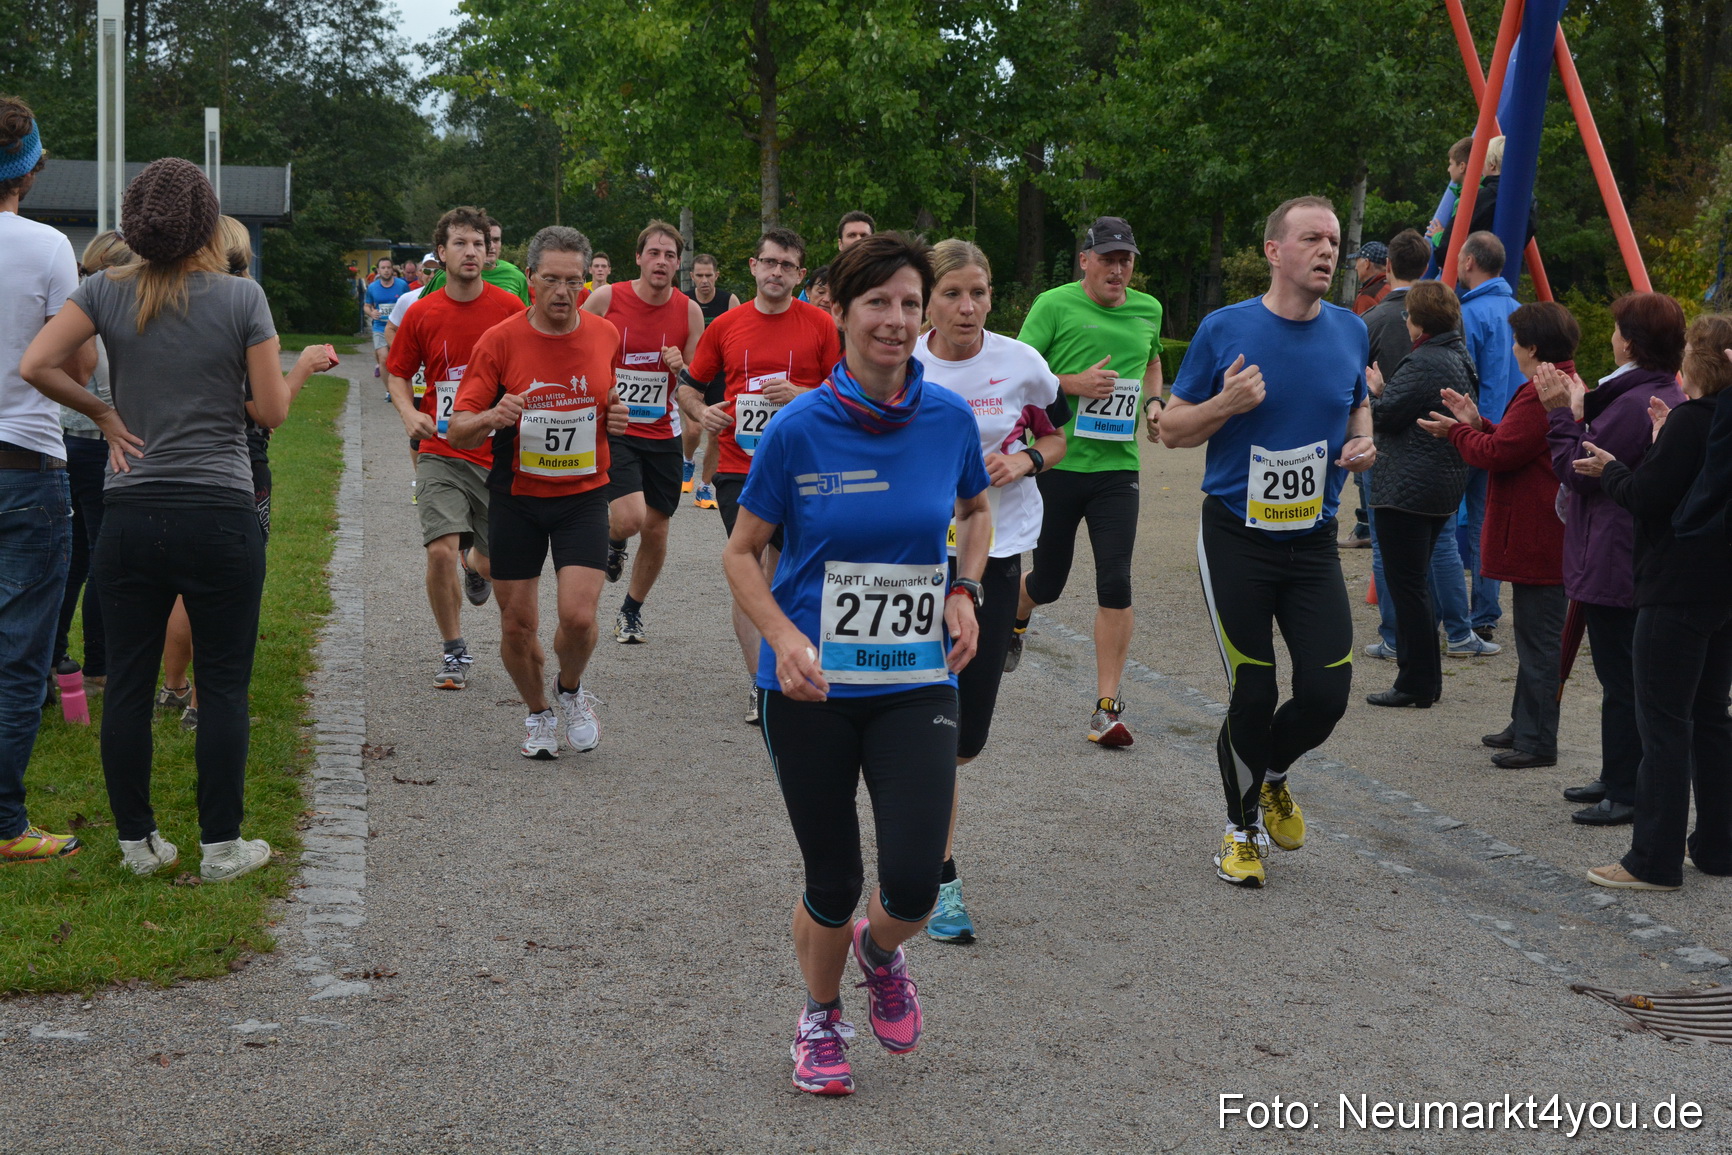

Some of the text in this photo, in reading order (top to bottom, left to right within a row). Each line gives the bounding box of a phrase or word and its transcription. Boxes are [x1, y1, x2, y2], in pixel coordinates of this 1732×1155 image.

[545, 392, 566, 401] Mitte
[617, 381, 663, 404] 2227
[527, 396, 595, 410] KASSEL MARATHON
[737, 399, 786, 408] PARTL Neumar
[966, 397, 1003, 408] NCHEN
[1085, 393, 1136, 418] 2278
[628, 407, 651, 416] lorian
[972, 406, 1004, 416] ATHON
[522, 415, 586, 425] PARTL Neumarkt
[1094, 420, 1125, 432] Helmut
[545, 427, 577, 452] 57
[538, 456, 580, 467] Andreas
[1276, 453, 1315, 467] Neumarkt
[1263, 465, 1316, 500] 298
[1264, 506, 1316, 519] Christian
[827, 573, 928, 588] PARTL Neumarkt
[835, 592, 935, 638] 2739
[856, 649, 917, 671] Brigitte
